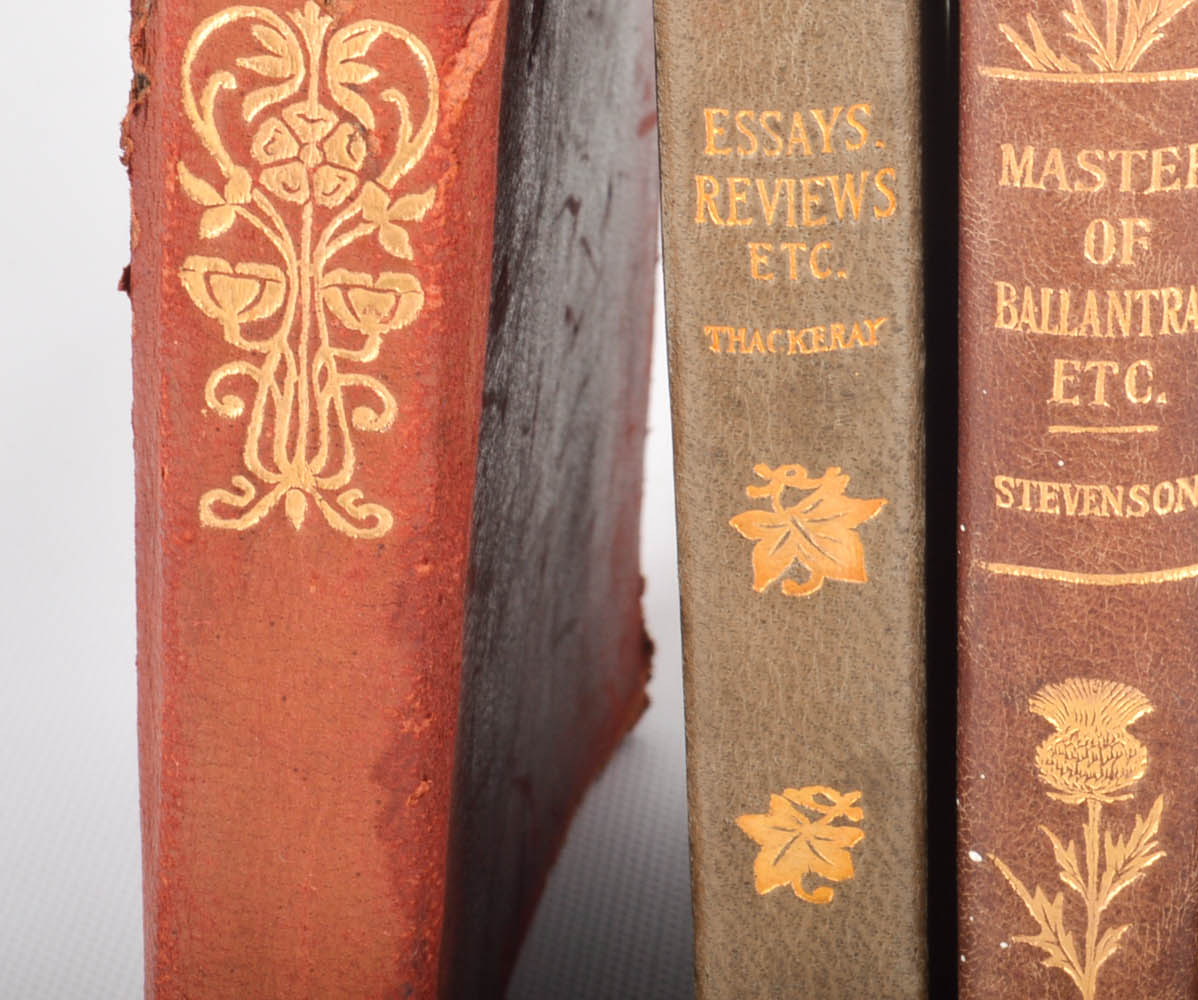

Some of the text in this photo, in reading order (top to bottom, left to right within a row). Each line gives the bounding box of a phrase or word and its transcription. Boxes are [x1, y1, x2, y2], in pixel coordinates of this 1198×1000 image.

[695, 167, 897, 228] REVIEWS
[747, 241, 848, 281] ETC.
[1083, 218, 1152, 266] OF
[703, 317, 888, 356] THACKERAY
[1047, 359, 1168, 407] ETC.
